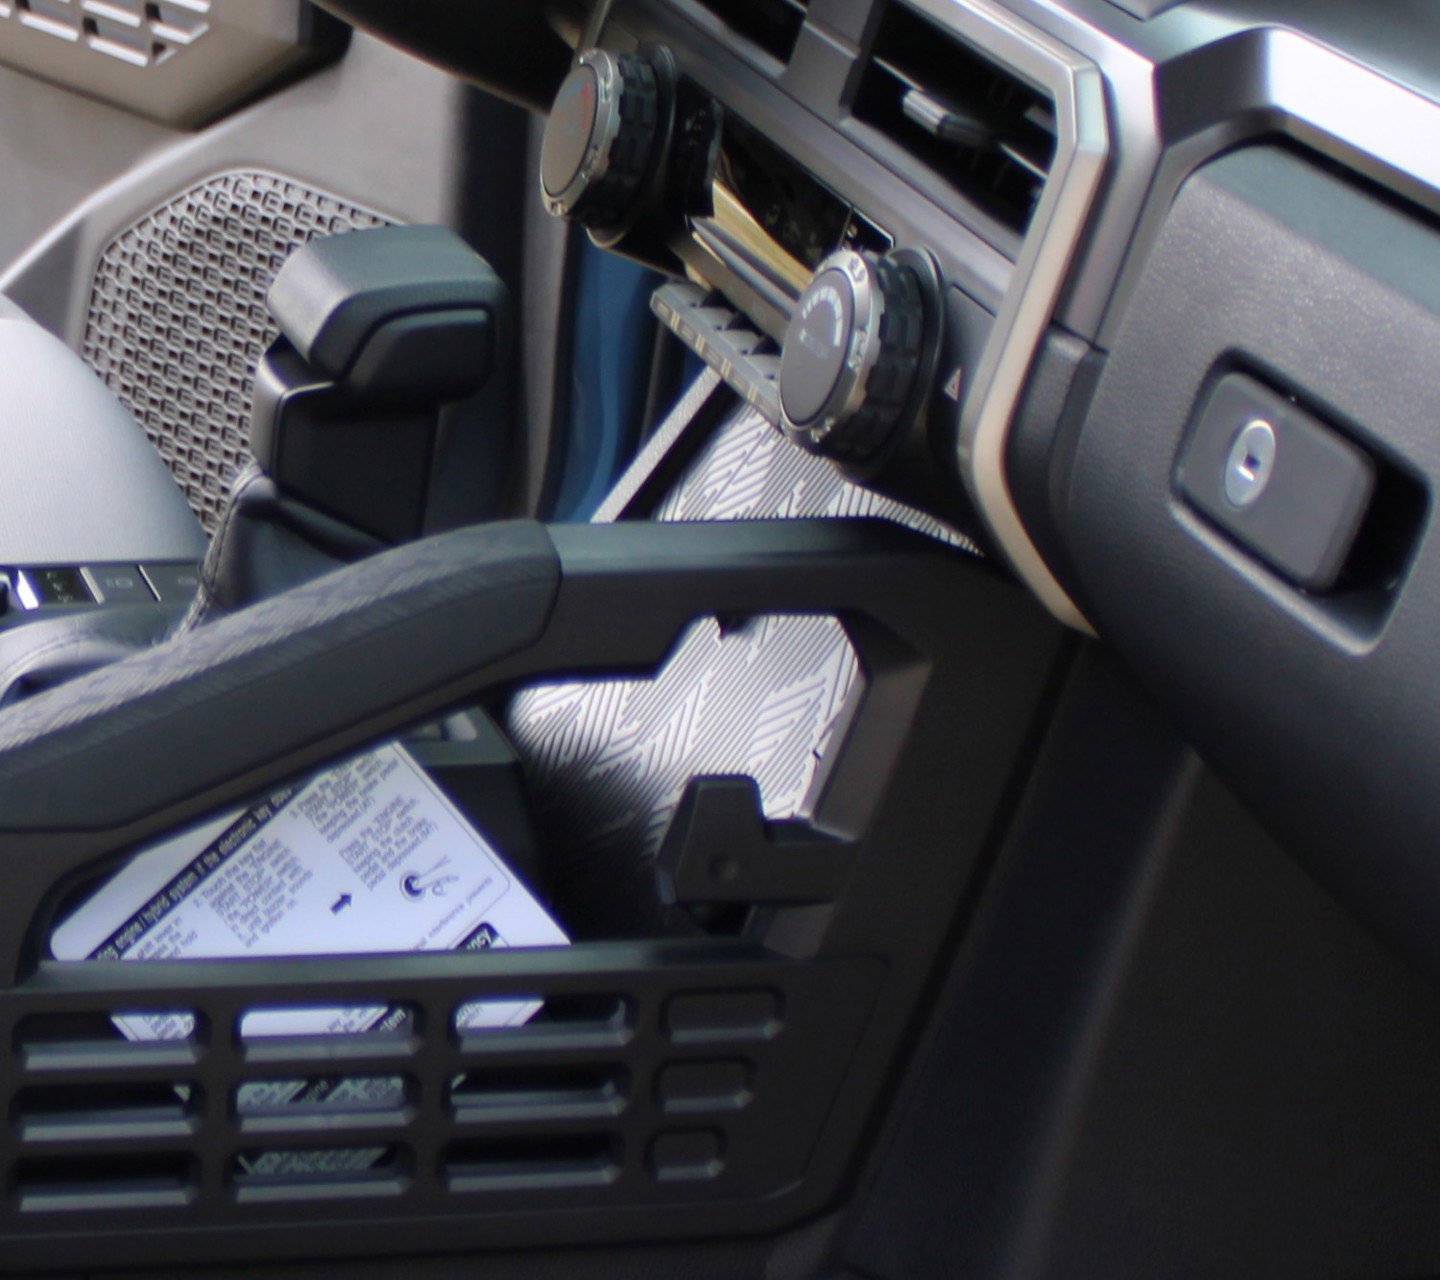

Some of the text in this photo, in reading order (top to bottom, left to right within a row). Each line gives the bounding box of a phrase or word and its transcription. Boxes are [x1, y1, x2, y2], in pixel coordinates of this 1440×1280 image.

[165, 868, 202, 903] system
[193, 860, 206, 875] if
[200, 848, 220, 868] the
[214, 815, 257, 855] electronic
[252, 802, 276, 826] key
